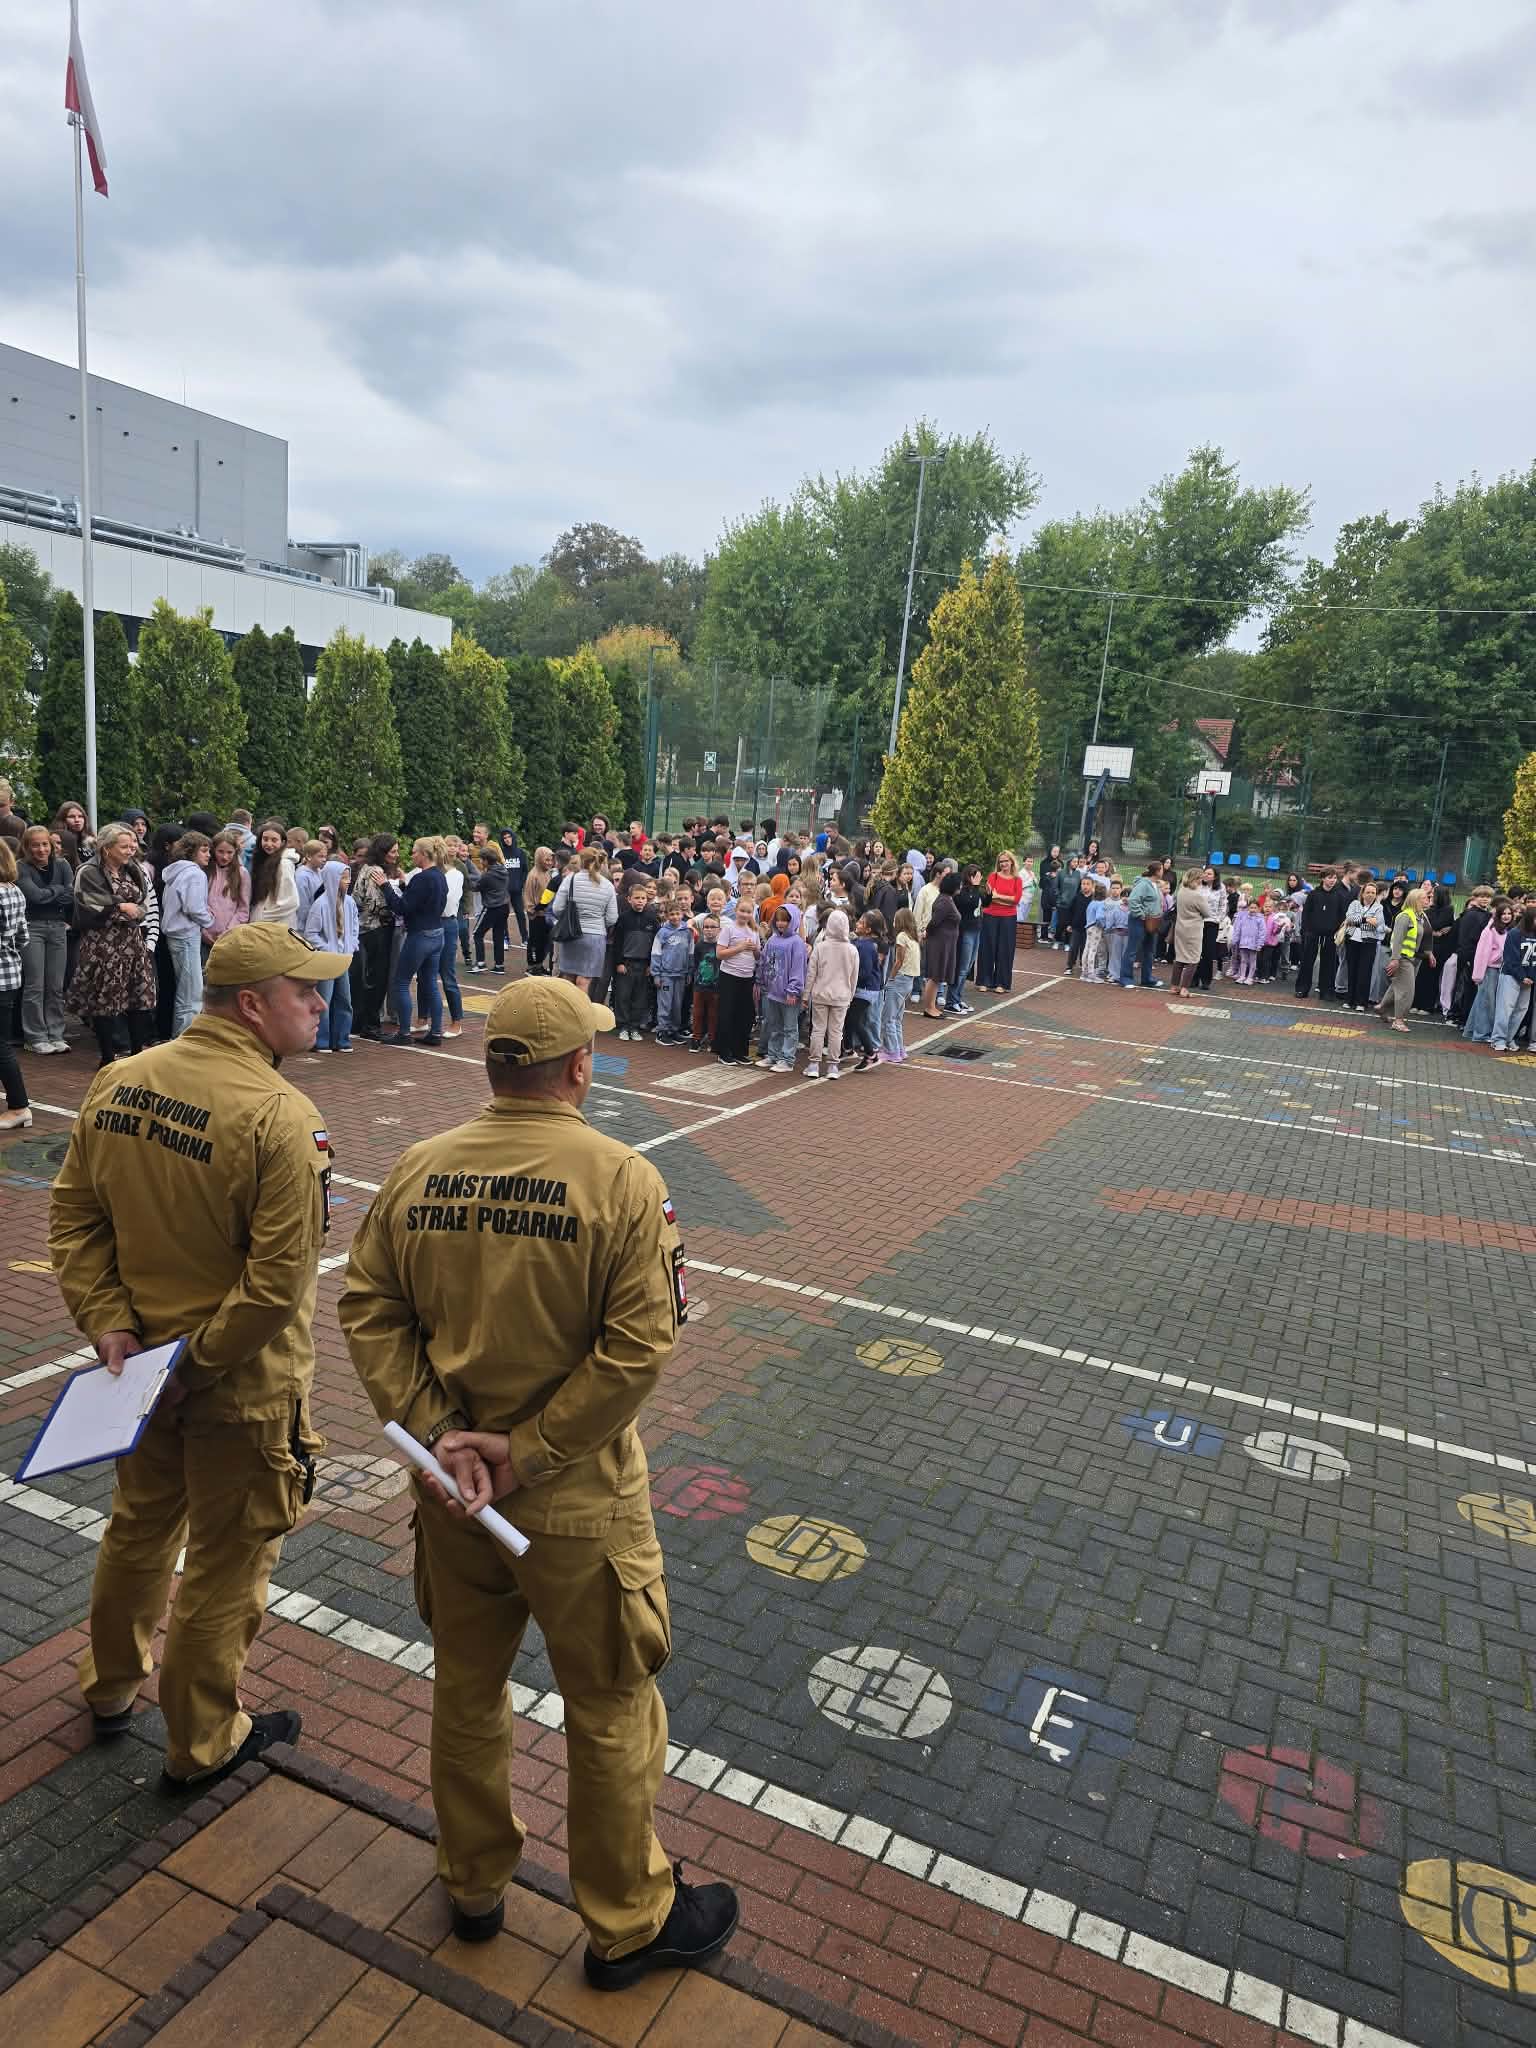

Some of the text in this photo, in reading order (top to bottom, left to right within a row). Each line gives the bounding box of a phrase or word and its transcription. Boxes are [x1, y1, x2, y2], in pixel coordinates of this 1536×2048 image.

[94, 1109, 143, 1137] STRAŻ
[110, 1085, 212, 1132] PAŃSTWOWA
[424, 1170, 568, 1207] PAŃSTWOWA
[407, 1205, 578, 1243] STRAŻ POŻARNA
[1153, 1420, 1191, 1446] U
[776, 1525, 840, 1563] D
[845, 1666, 911, 1729] E
